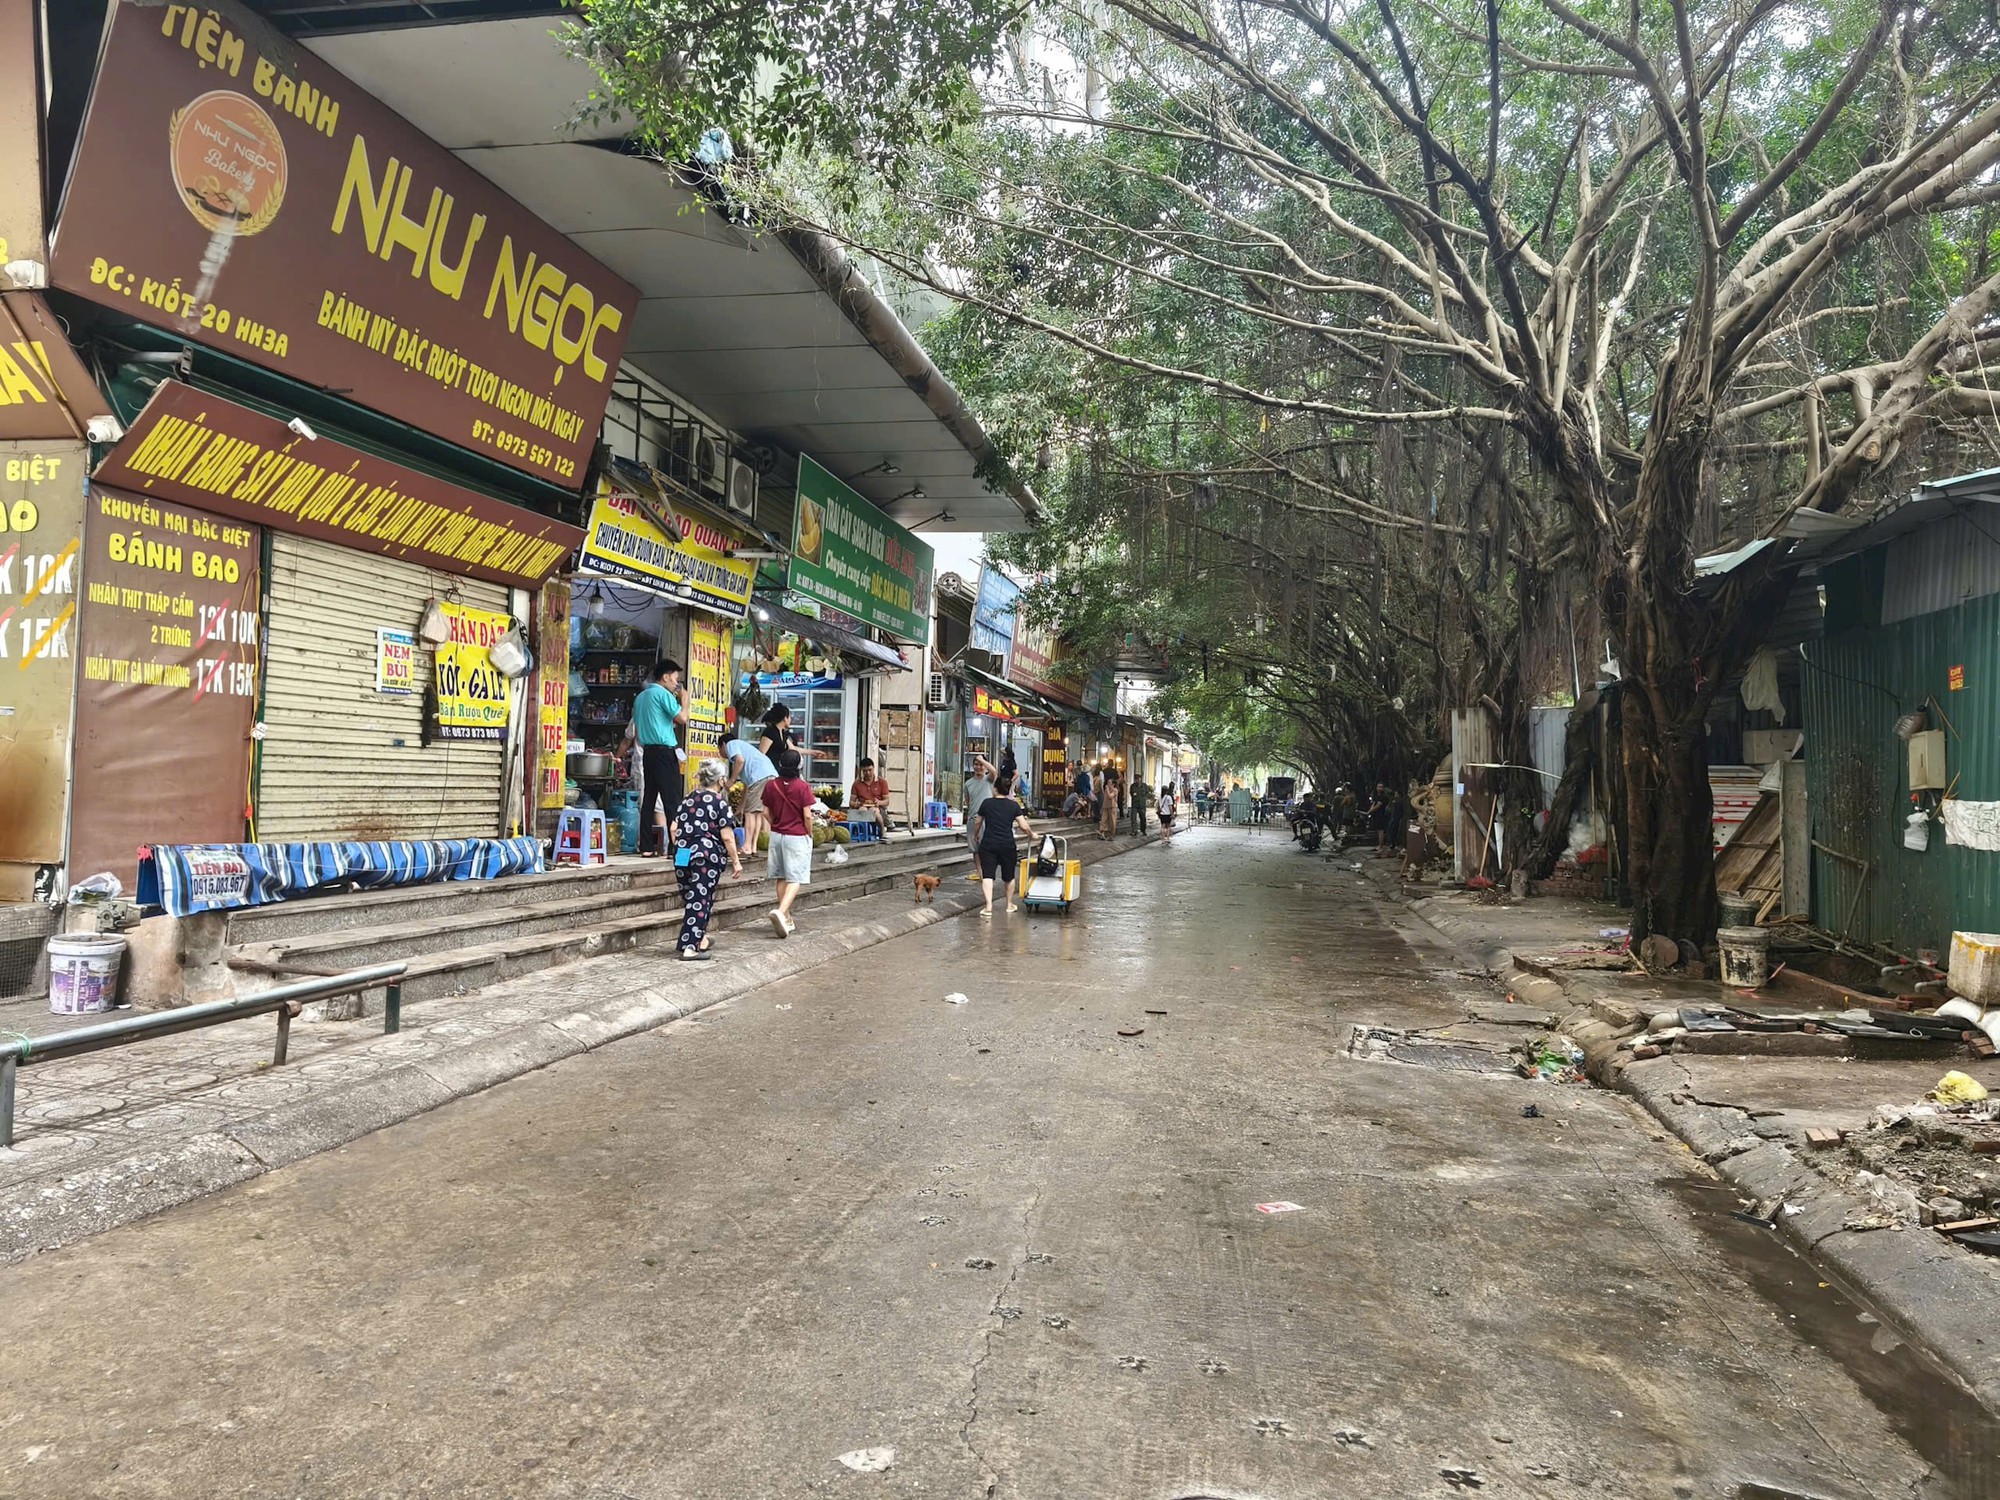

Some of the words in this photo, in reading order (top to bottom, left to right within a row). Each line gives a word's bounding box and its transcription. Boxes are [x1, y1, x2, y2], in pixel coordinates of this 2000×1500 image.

[161, 4, 245, 77] TIỆM
[253, 56, 339, 138] BÁNH
[204, 148, 256, 193] Bakery
[233, 142, 277, 174] NGỌC
[331, 133, 487, 301] NHƯ
[483, 234, 623, 386] NGỌC
[90, 257, 135, 296] ĐC:
[200, 303, 231, 334] 20
[235, 317, 289, 358] HH3A
[0, 340, 67, 406] AY
[317, 289, 371, 344] BÁNH
[393, 326, 429, 373] ĐẶC
[425, 343, 468, 390] RUỘT
[495, 379, 534, 421] NGON
[551, 409, 585, 444] NGÀY
[6, 453, 62, 486] BIỆT
[125, 412, 213, 488] NHẬN
[180, 433, 261, 495] RANG
[471, 419, 495, 444] ĐT:
[496, 430, 528, 457] 0973
[529, 444, 553, 468] 567
[554, 455, 575, 478] 122
[231, 437, 302, 504] SẤY
[264, 461, 326, 514] HOA
[296, 459, 361, 523] QUẢ
[0, 499, 39, 533] O
[328, 482, 368, 526] &
[343, 480, 398, 534] CÁC
[369, 495, 427, 551] LOẠI
[164, 511, 188, 536] MẠI
[192, 517, 219, 542] ĐẶC
[222, 526, 251, 550] BIỆT
[399, 504, 451, 556] HẠT
[694, 524, 729, 553] QUÂN
[23, 553, 76, 595] 10K
[108, 530, 183, 574] BÁNH
[191, 551, 241, 584] BAO
[518, 541, 567, 580] NGAY
[88, 581, 119, 606] NHÂN
[121, 587, 144, 613] THỊT
[145, 590, 171, 617] THẬP
[172, 591, 194, 618] CẨM
[19, 617, 71, 659] 15K
[150, 625, 158, 643] 2
[159, 624, 192, 648] TRỨNG
[198, 604, 228, 642] 12K
[230, 609, 259, 646] 10K
[446, 611, 477, 650] HẬN
[85, 653, 110, 681] NHÂN
[111, 658, 130, 687] THỊT
[130, 657, 143, 684] GÀ
[384, 643, 411, 660] NEM
[386, 660, 408, 678] BÙI
[195, 658, 226, 694] 17K
[228, 661, 255, 697] 15K
[779, 676, 813, 685] ALASKA
[543, 717, 563, 750] TRẺ
[1048, 726, 1061, 741] GIA
[543, 768, 560, 793] EM
